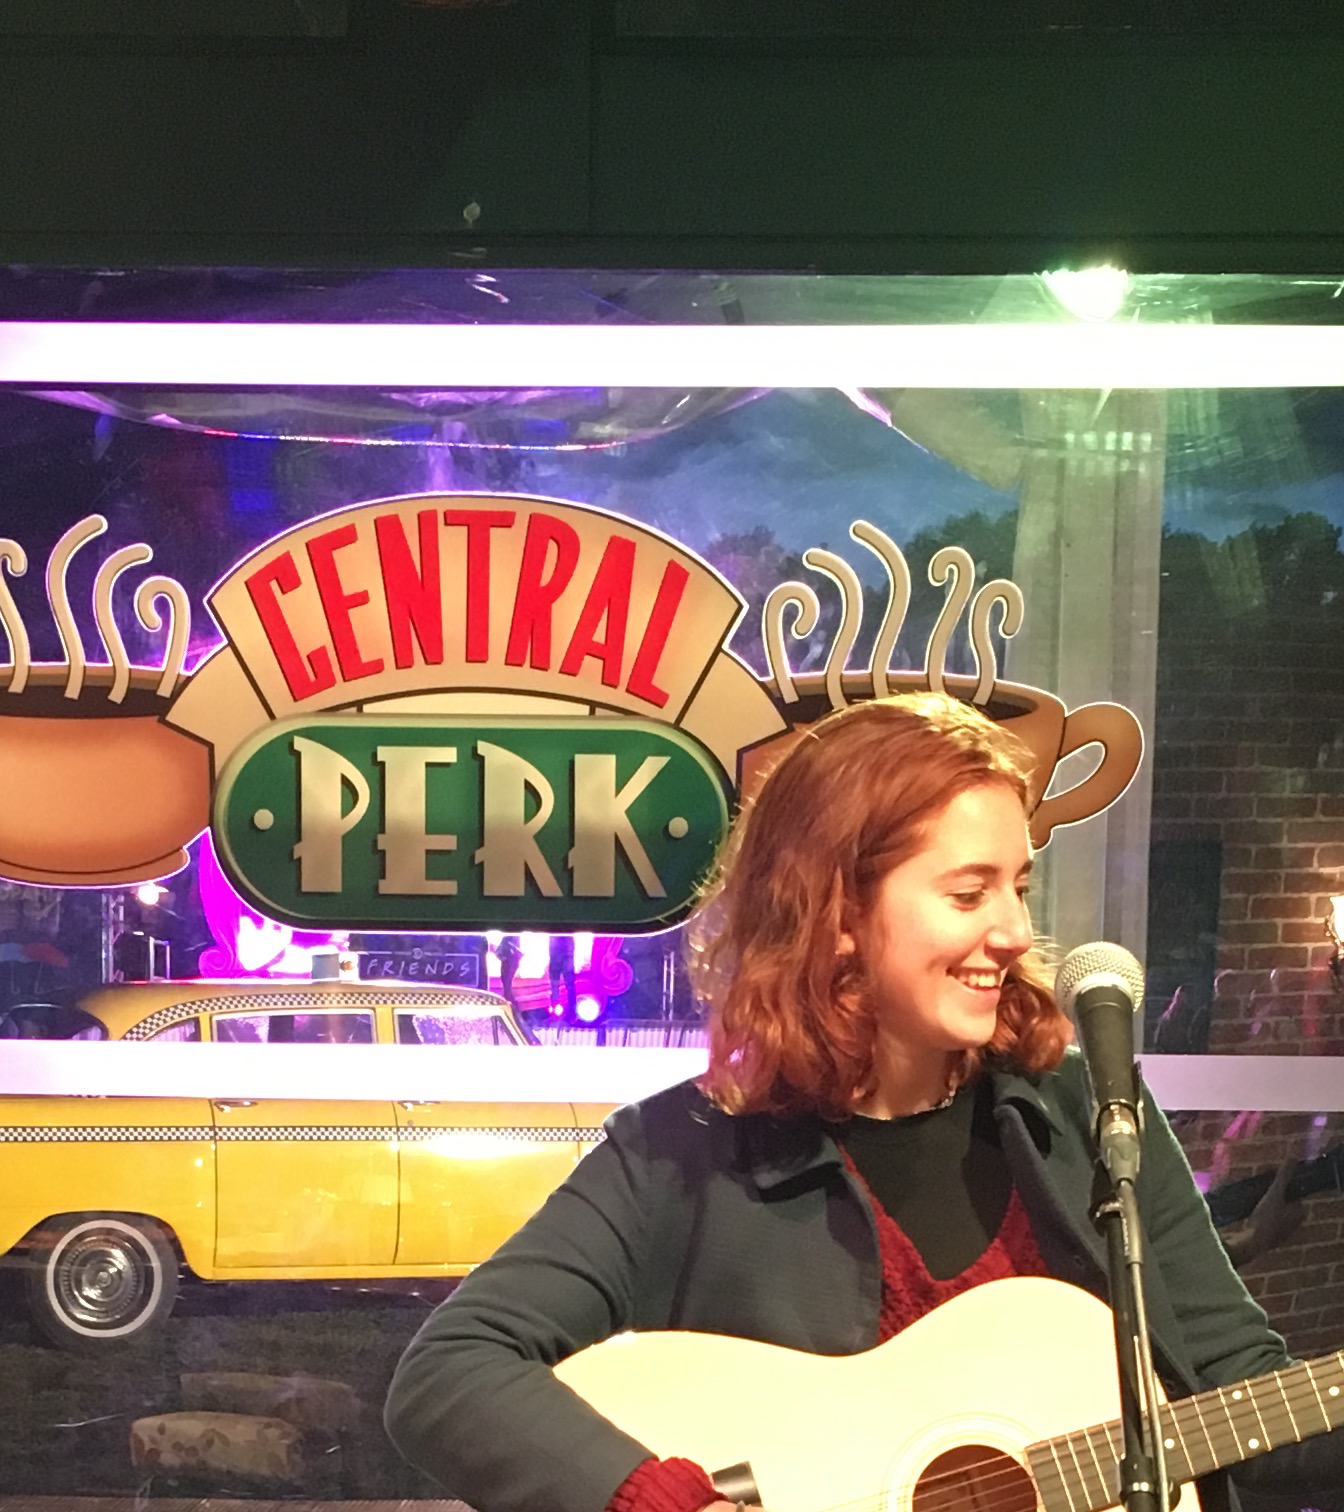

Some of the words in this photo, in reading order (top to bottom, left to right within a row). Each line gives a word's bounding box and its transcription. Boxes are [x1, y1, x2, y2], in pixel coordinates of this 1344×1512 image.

[245, 509, 690, 708] CENTRAL
[291, 735, 672, 898] PERK
[366, 958, 471, 978] FRIENDS
